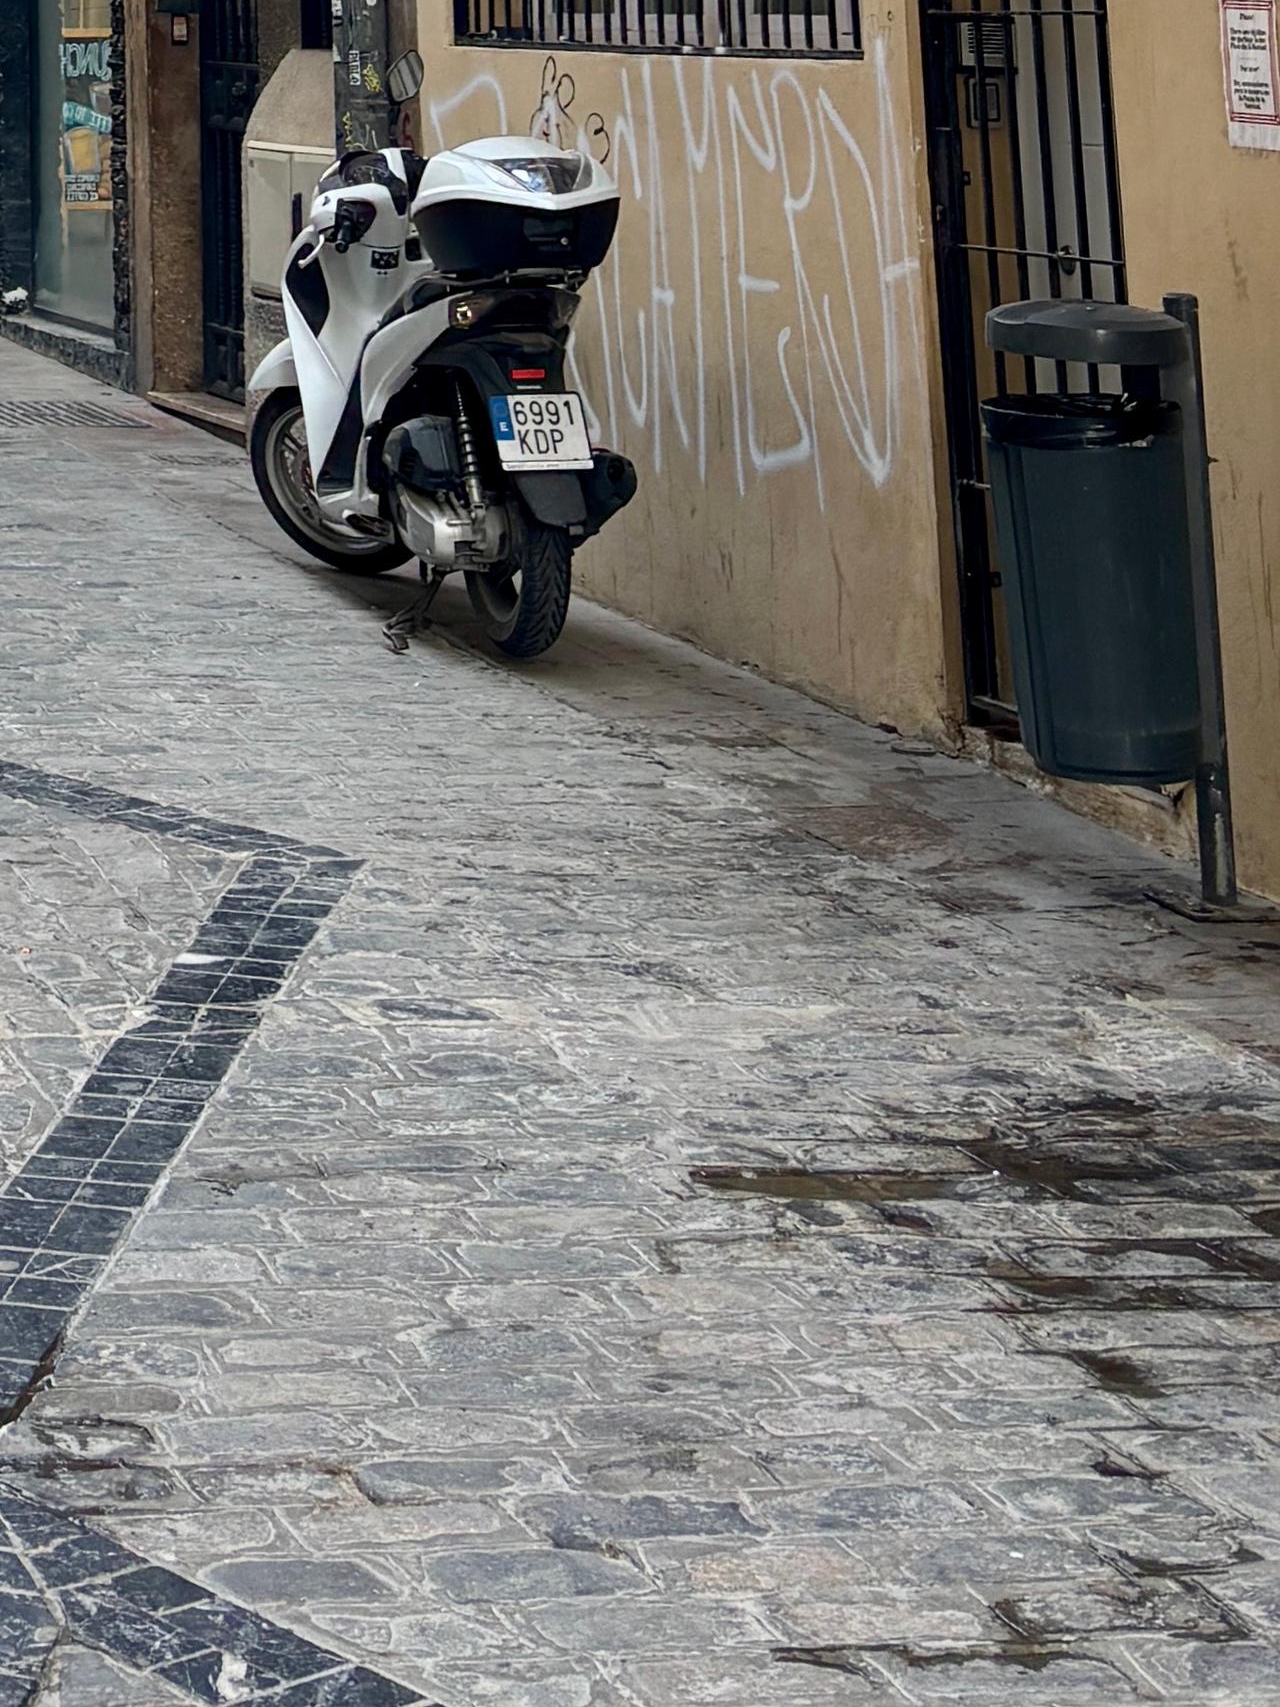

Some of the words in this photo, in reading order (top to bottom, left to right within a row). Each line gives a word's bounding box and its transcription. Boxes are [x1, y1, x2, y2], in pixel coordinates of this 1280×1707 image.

[513, 400, 574, 425] 6991
[499, 422, 509, 432] E
[517, 429, 564, 455] KDP
